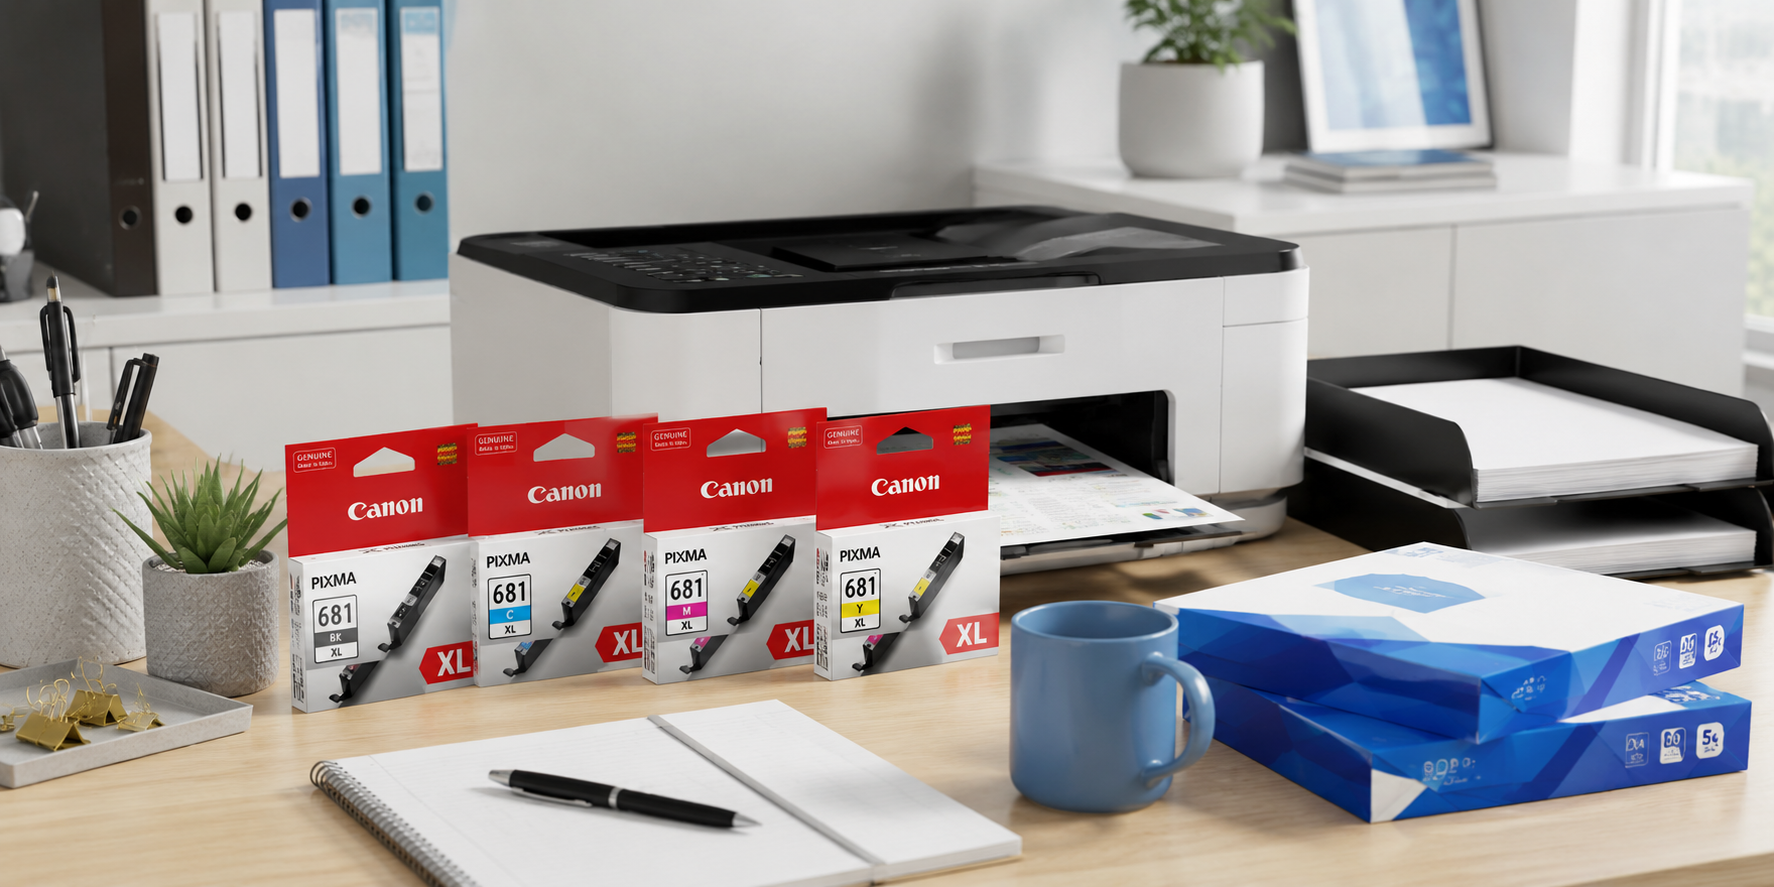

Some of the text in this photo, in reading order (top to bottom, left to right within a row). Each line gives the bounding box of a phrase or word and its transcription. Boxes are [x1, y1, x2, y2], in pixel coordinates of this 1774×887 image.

[527, 482, 602, 504] Canon
[700, 477, 773, 499] Canon
[871, 474, 940, 497] Canon
[347, 497, 423, 521] Canon
[486, 552, 531, 568] PIXMA
[665, 548, 707, 565] PIXMA
[840, 546, 881, 562] PIXMA
[311, 572, 357, 590] PIXMA
[670, 577, 703, 601] 681
[845, 576, 875, 598] 681
[493, 581, 526, 604] 681
[318, 602, 352, 627] 681
[506, 609, 514, 620] C
[682, 606, 691, 616] M
[856, 603, 864, 613] Y
[504, 625, 516, 635] XL
[681, 620, 693, 631] XL
[854, 618, 866, 628] XL
[329, 632, 342, 642] BK
[612, 628, 643, 656] XL
[784, 626, 814, 653] XL
[956, 621, 987, 648] XL
[330, 647, 342, 658] XL
[437, 648, 471, 677] XL
